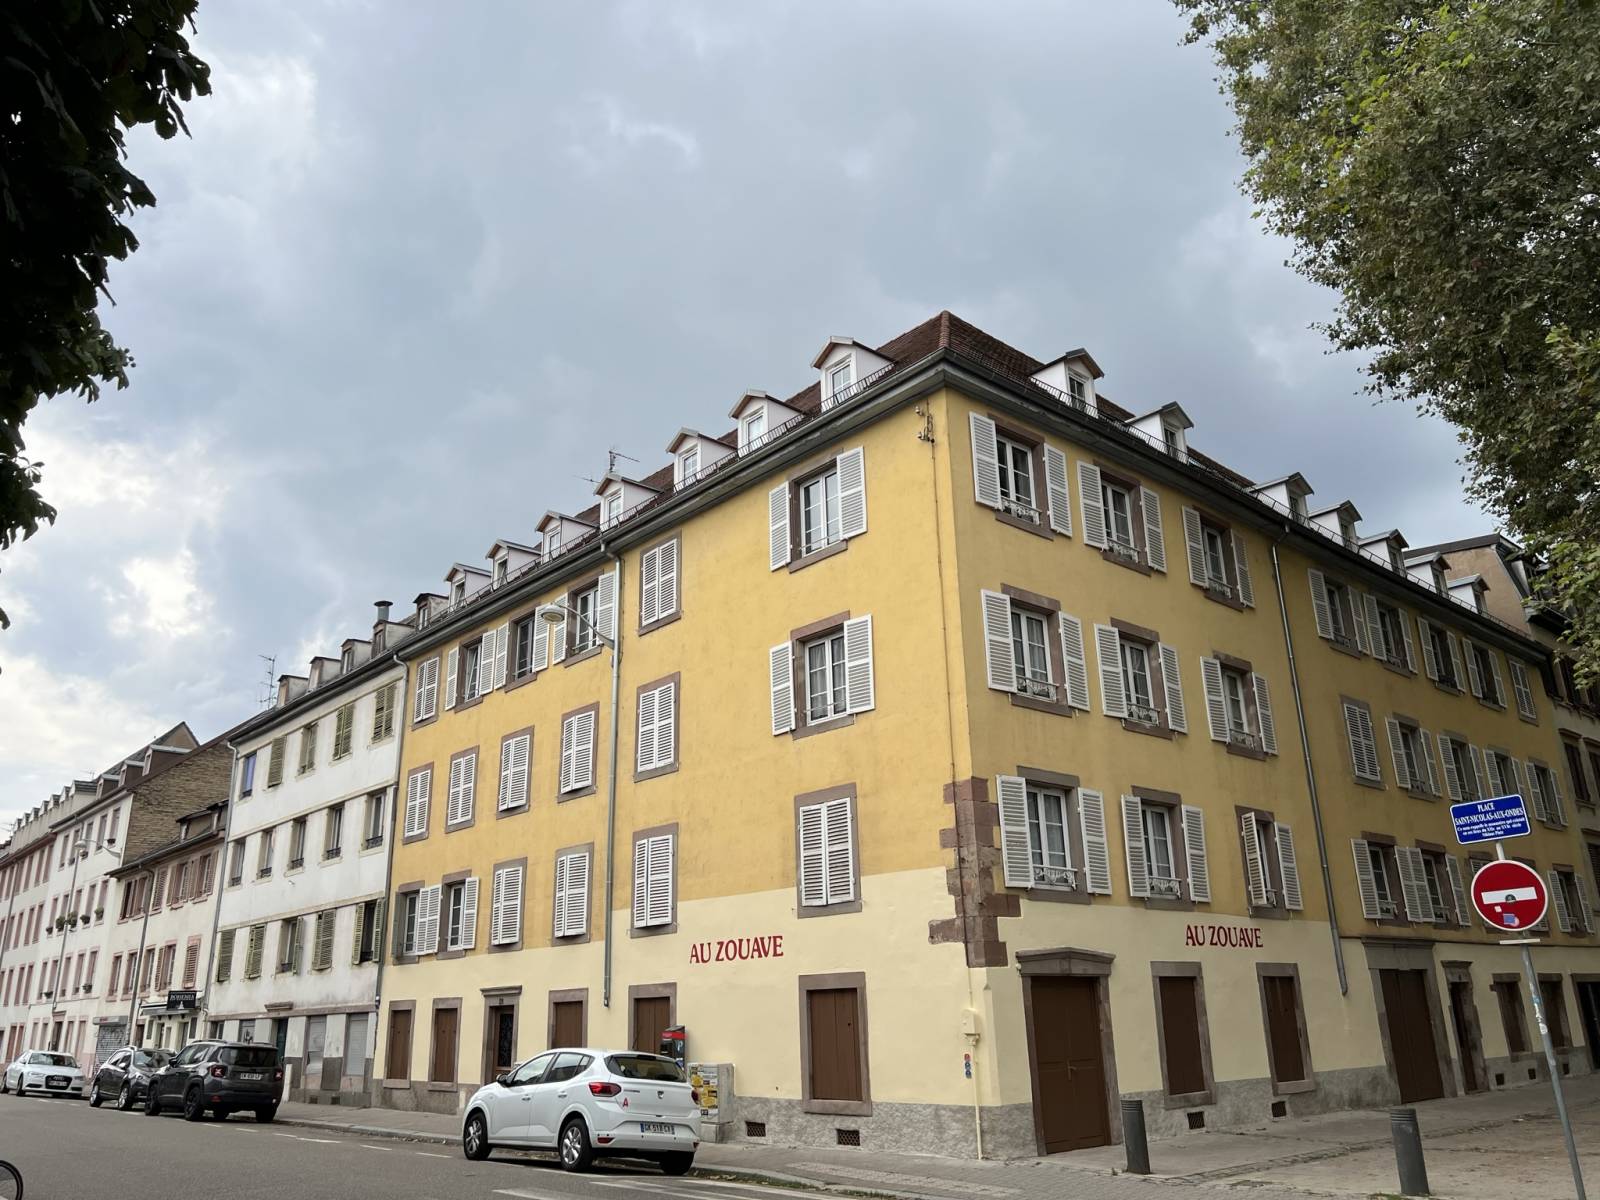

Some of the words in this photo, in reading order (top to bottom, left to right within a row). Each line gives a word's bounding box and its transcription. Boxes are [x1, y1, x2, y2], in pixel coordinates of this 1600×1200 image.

[1477, 802, 1495, 812] PLACE
[1454, 808, 1524, 825] SAINT-NICOLAS-AUX-ONDES
[1185, 924, 1206, 947] AU
[1208, 925, 1264, 948] ZOUAVE
[689, 942, 711, 964] AU
[715, 935, 784, 962] ZOUAVE
[622, 1097, 629, 1108] A
